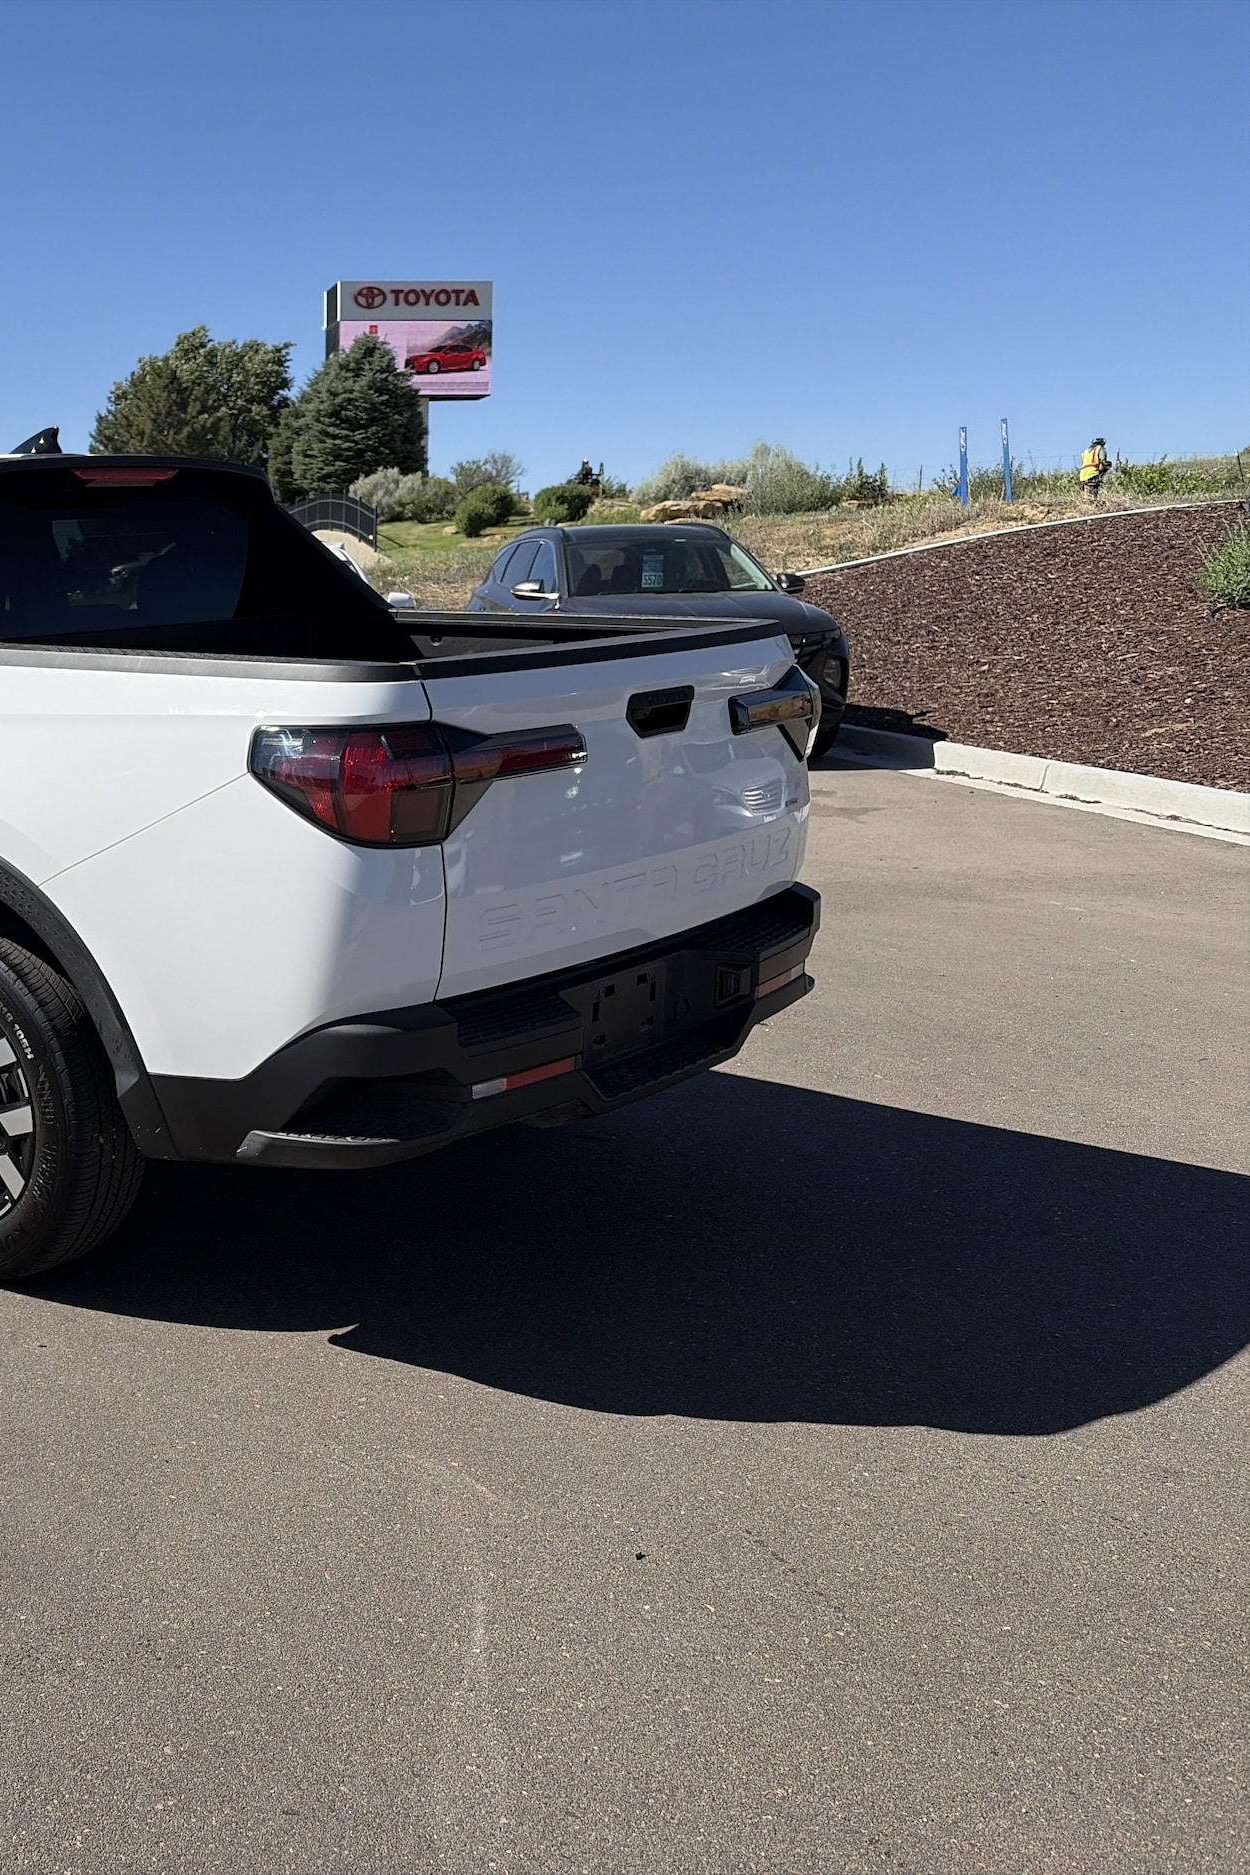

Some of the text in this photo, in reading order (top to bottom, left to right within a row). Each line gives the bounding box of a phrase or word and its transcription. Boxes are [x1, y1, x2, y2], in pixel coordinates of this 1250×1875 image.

[390, 289, 480, 306] TOYOTA
[478, 828, 792, 951] SANTA CRUZ
